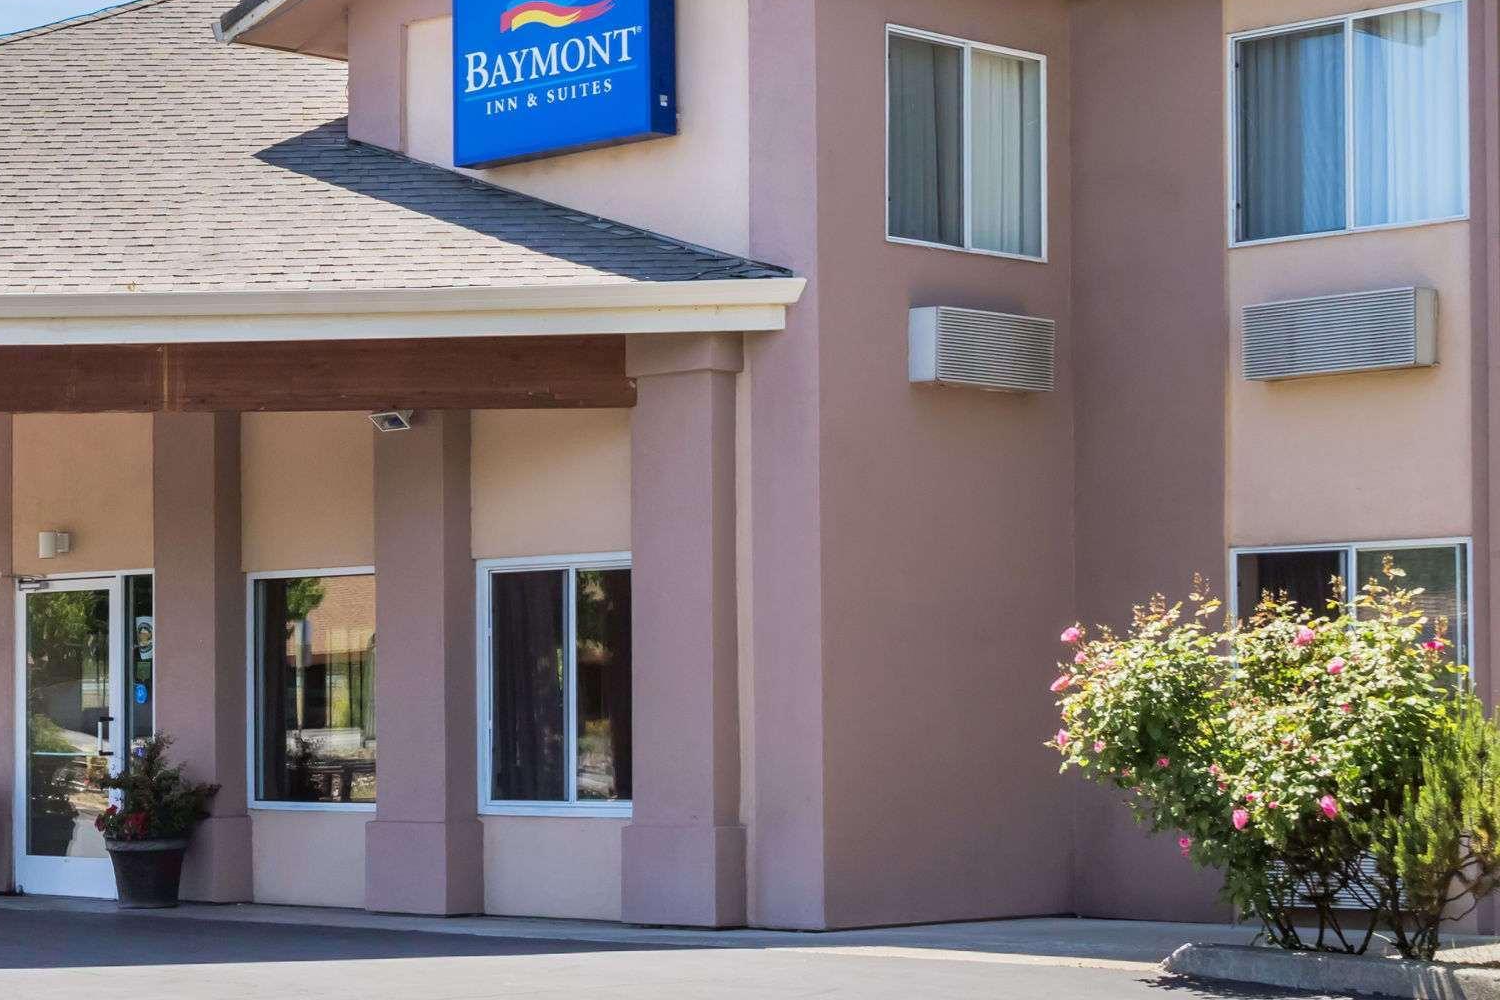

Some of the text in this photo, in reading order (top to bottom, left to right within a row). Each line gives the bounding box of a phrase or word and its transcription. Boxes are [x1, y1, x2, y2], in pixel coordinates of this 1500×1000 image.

[464, 26, 637, 93] BAYMONT
[486, 78, 613, 115] INN & SUITES
